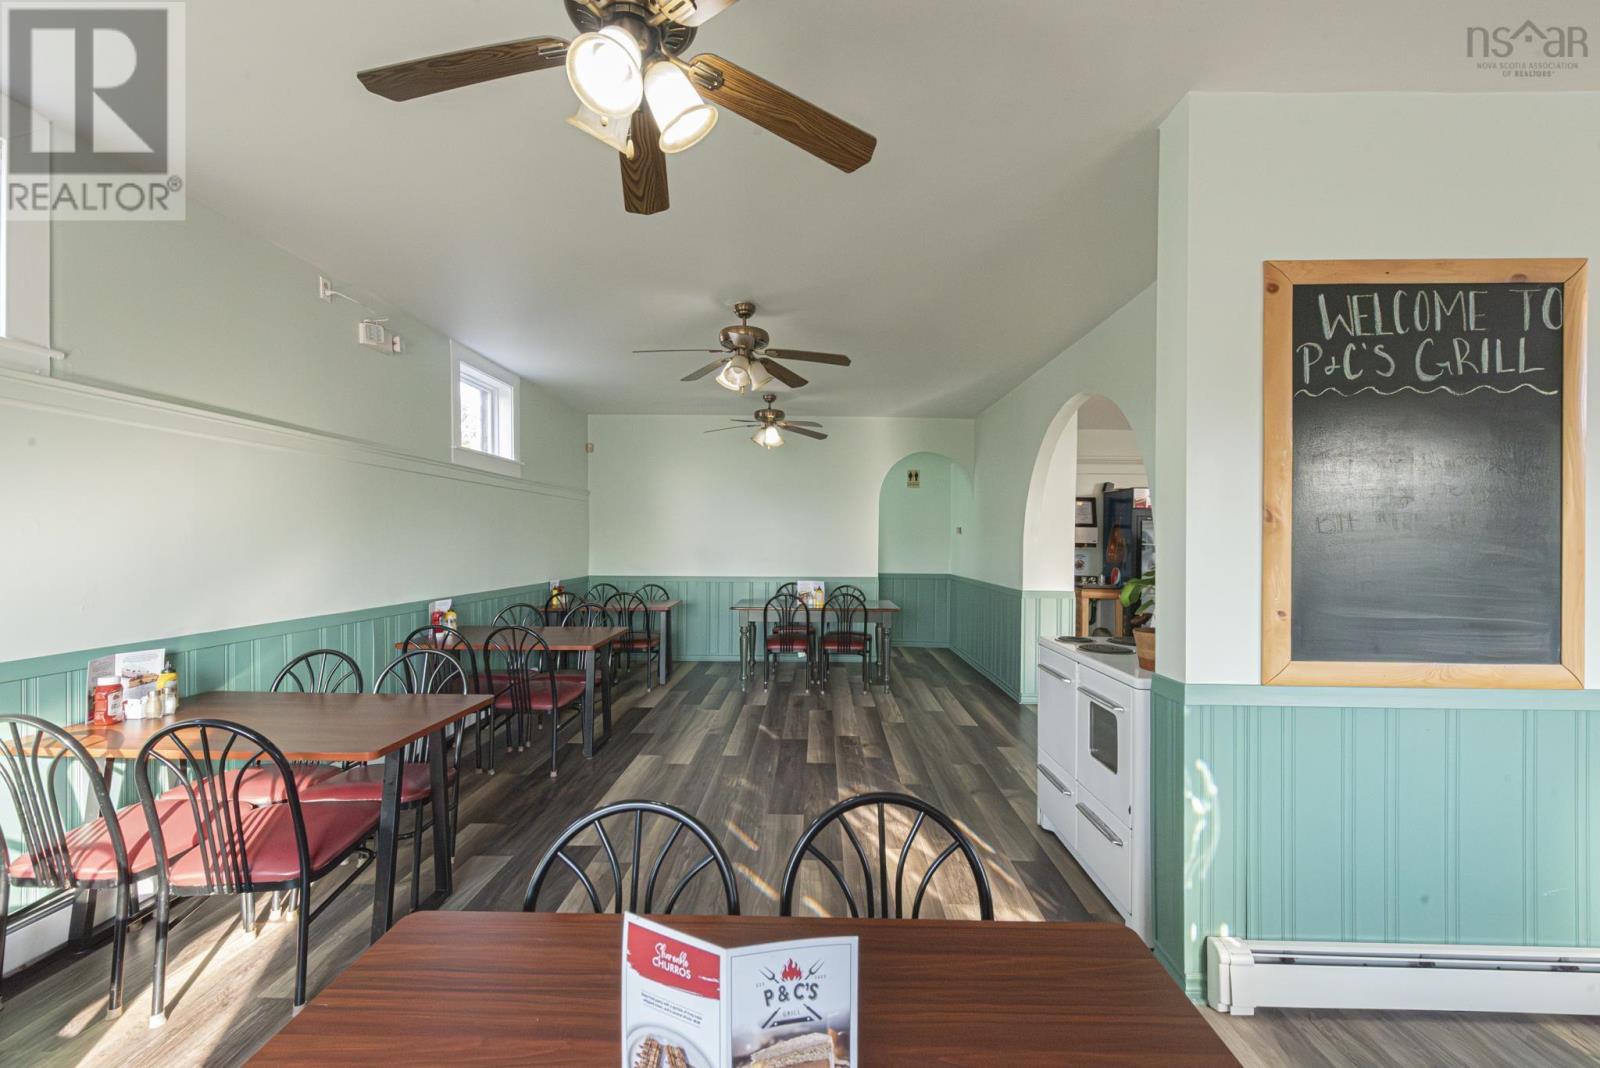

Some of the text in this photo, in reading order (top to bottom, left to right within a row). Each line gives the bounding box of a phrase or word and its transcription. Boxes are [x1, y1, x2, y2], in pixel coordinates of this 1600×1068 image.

[1318, 286, 1564, 340] WELCOME TO
[1415, 336, 1545, 382] GRILL
[651, 956, 692, 980] CHURROS
[763, 982, 819, 1007] P & C'S
